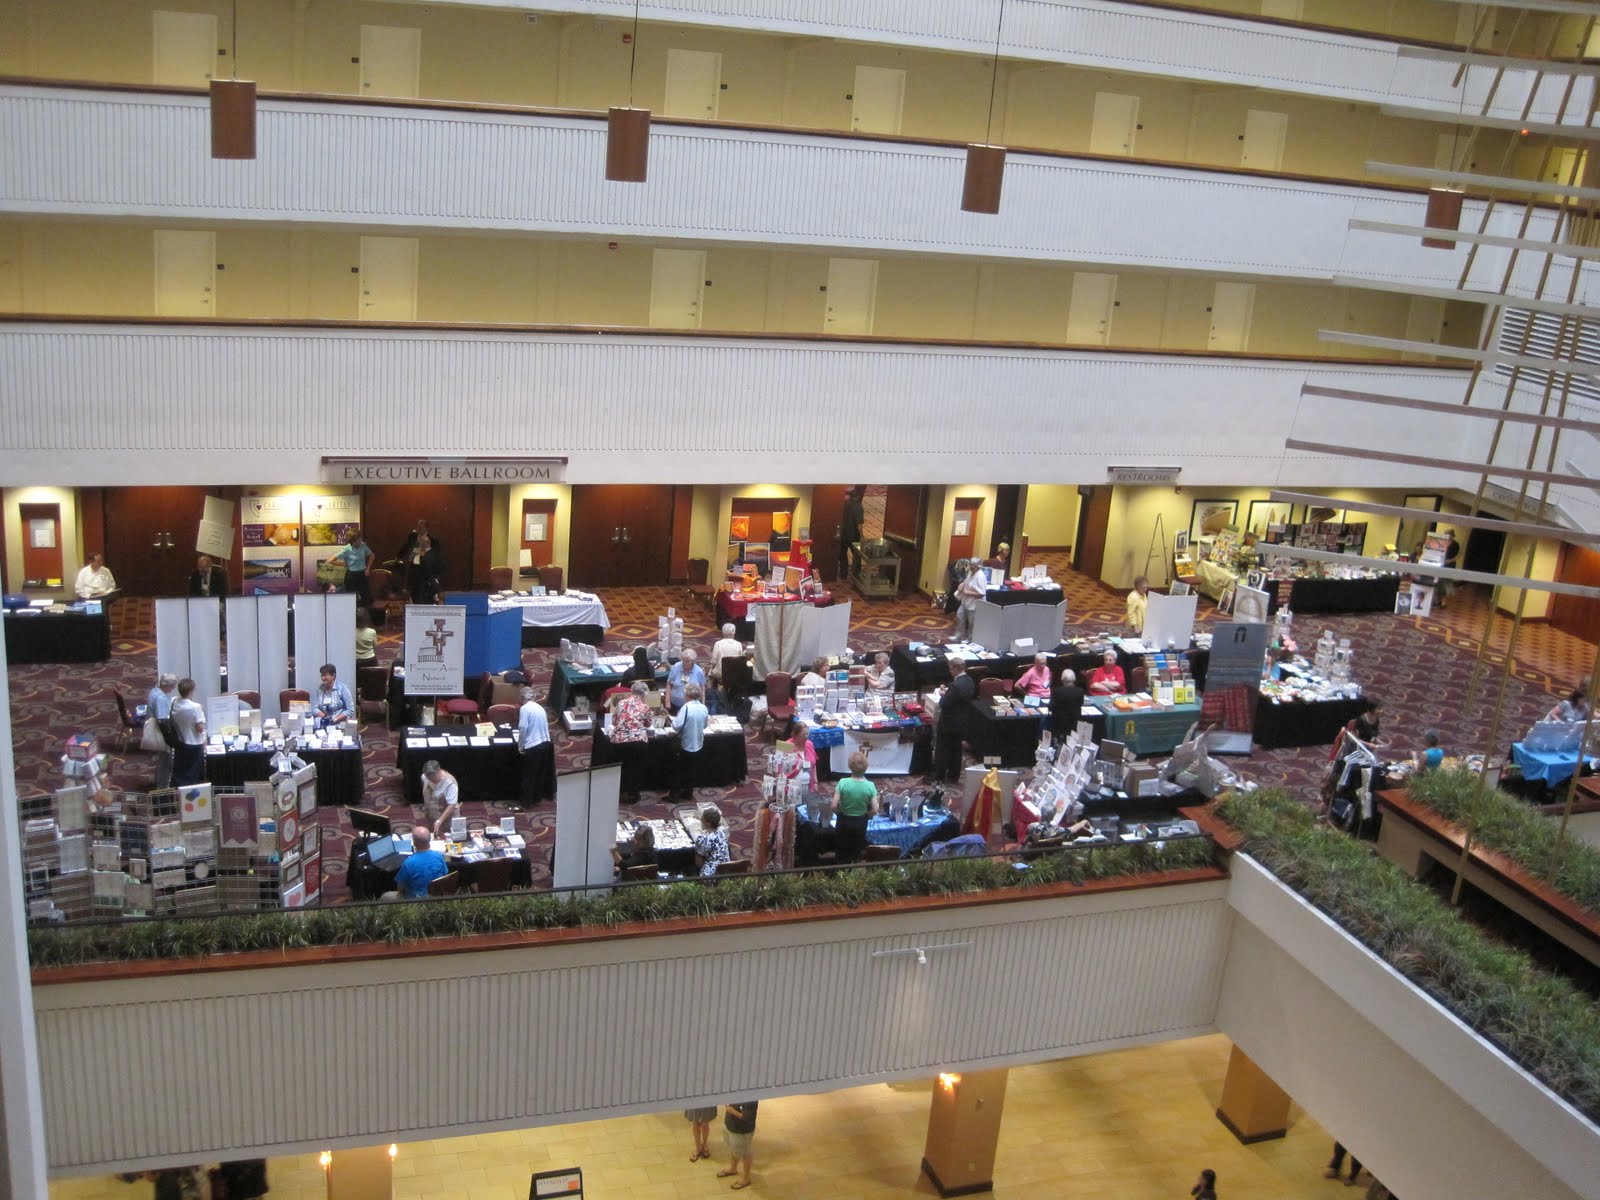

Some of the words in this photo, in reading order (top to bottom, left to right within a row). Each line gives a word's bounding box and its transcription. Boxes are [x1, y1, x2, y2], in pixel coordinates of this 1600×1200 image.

[344, 466, 442, 479] EXECUTIVE
[450, 466, 551, 479] BALLROOM
[1116, 472, 1171, 481] RESTROOMS
